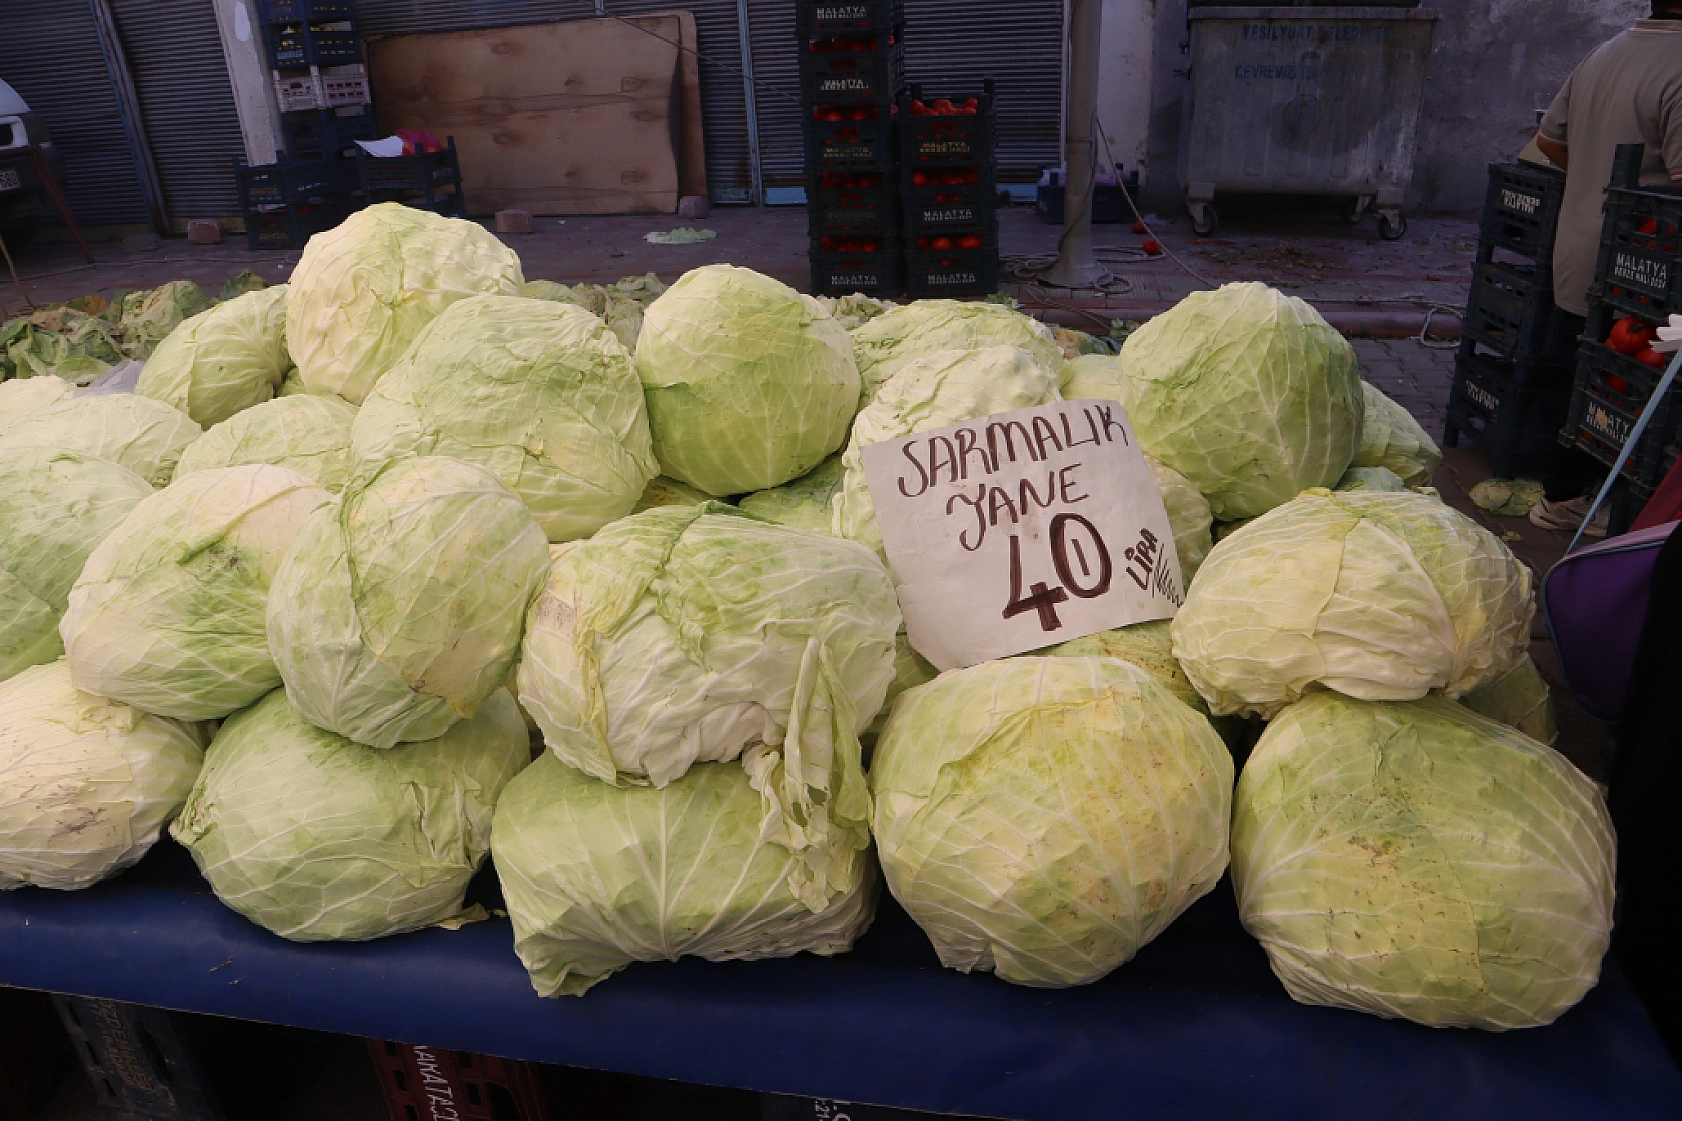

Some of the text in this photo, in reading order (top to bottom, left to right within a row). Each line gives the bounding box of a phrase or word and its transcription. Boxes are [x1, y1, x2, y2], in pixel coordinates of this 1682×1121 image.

[1615, 252, 1667, 281] MALATYA
[897, 404, 1129, 498] SARMALIK
[1001, 512, 1113, 632] 40
